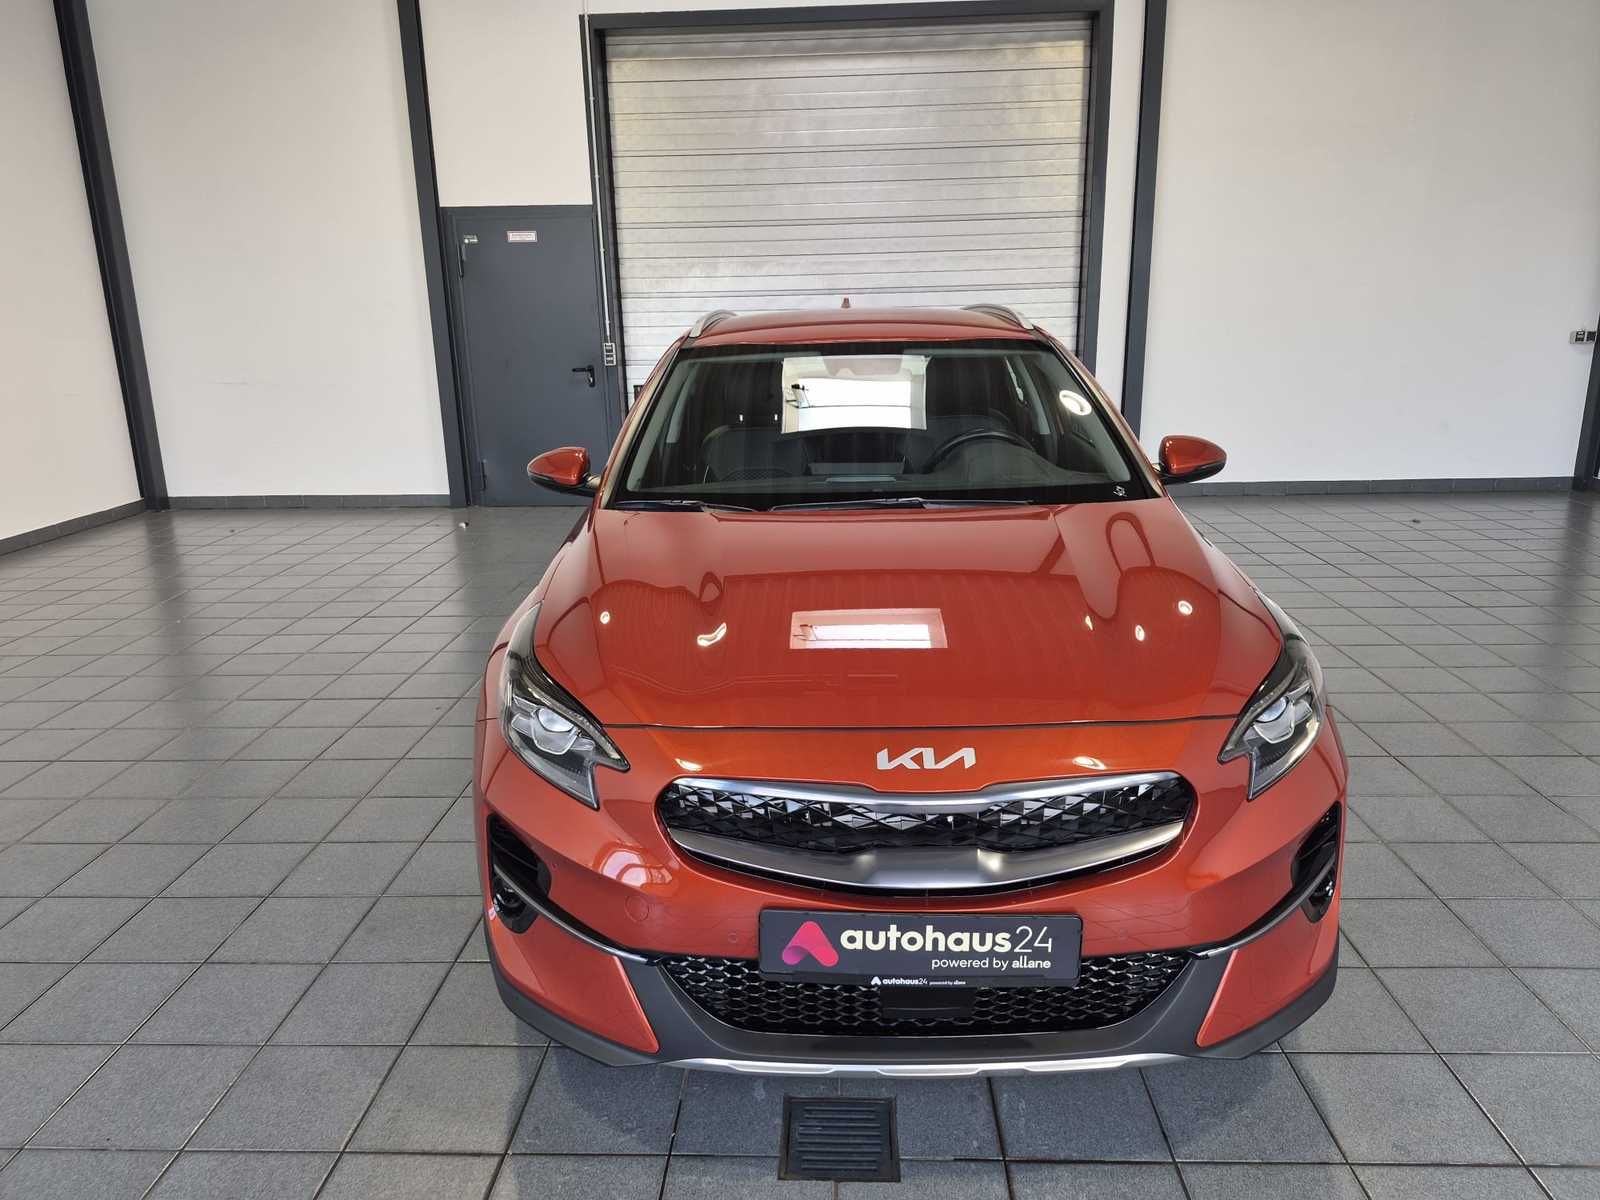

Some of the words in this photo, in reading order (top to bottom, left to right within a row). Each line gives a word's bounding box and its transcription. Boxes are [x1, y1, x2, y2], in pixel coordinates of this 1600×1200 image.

[876, 747, 977, 770] KIA
[840, 924, 1052, 953] autohaus24
[931, 957, 989, 970] powered
[992, 957, 1009, 970] by
[1011, 955, 1051, 969] allane
[882, 977, 928, 985] autohaus24
